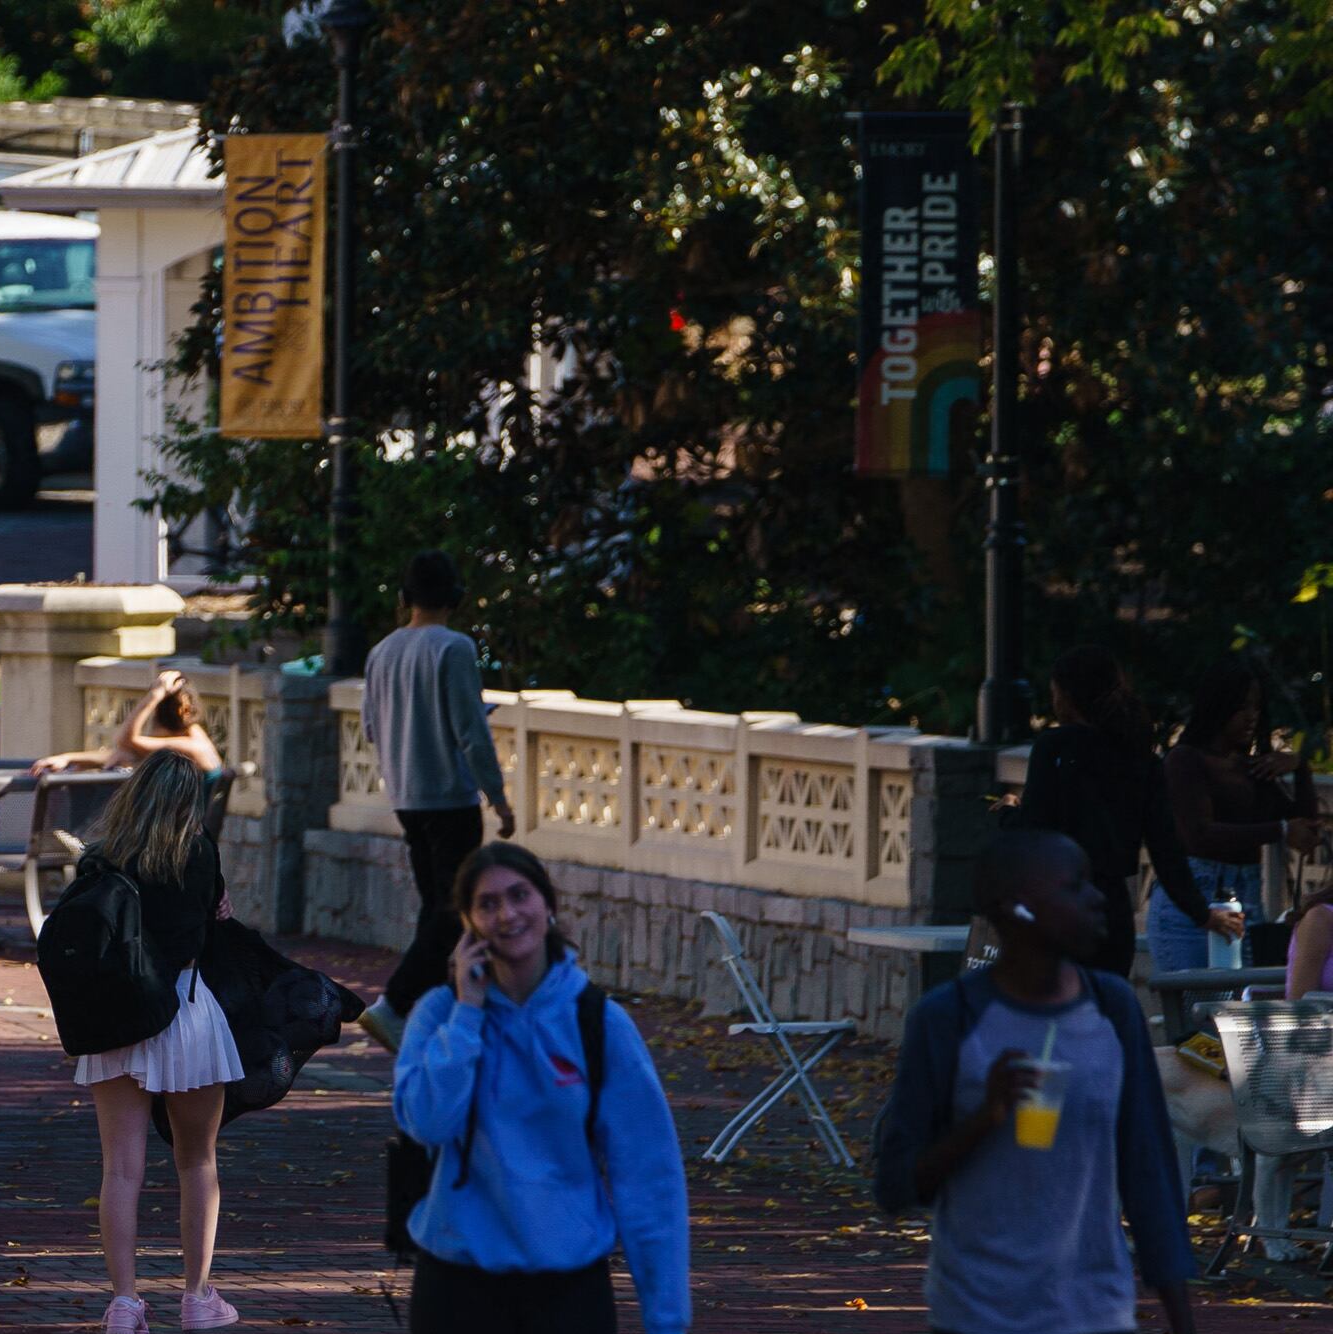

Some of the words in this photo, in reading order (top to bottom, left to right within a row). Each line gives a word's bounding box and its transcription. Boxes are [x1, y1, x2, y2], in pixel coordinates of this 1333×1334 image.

[232, 175, 277, 386] AMBITION
[275, 149, 314, 307] HEART
[880, 206, 919, 405] TOGETHER
[922, 172, 958, 283] PRIDE
